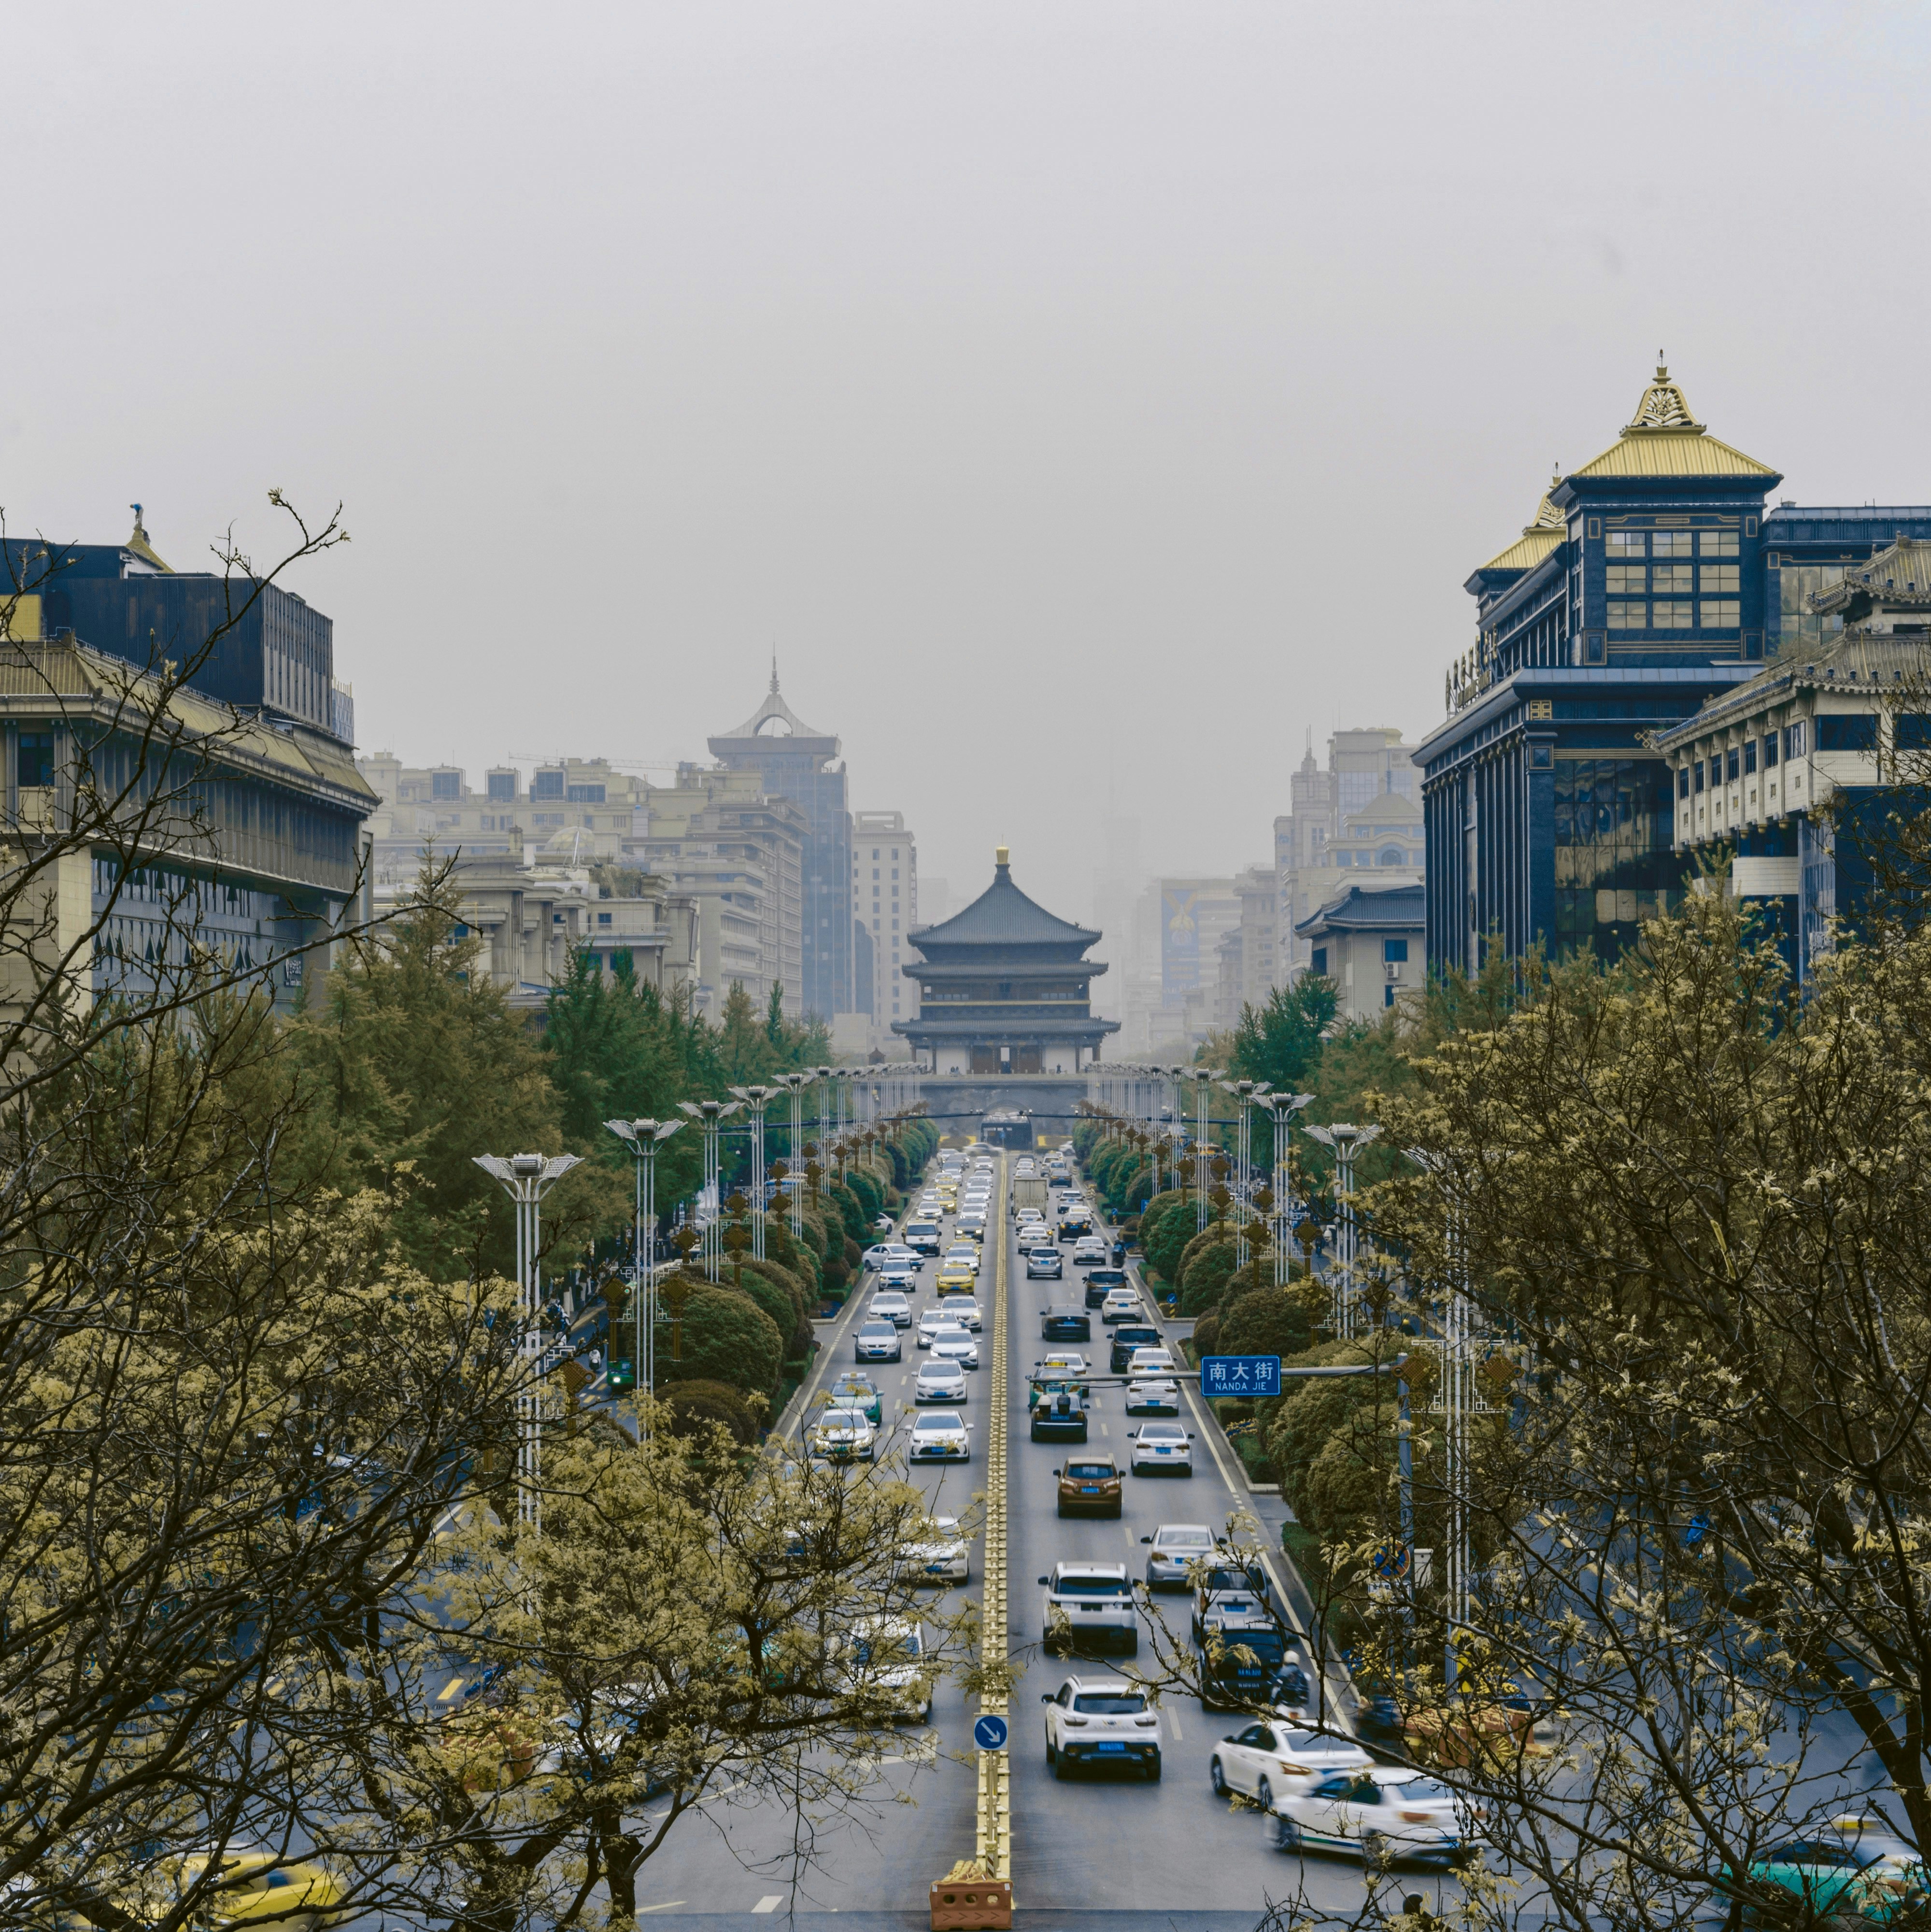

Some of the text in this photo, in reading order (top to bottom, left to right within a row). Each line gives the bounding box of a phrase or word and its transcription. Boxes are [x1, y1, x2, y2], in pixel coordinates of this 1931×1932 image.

[1209, 1362, 1273, 1380] 南大街
[1215, 1382, 1266, 1391] NANDA JIE
